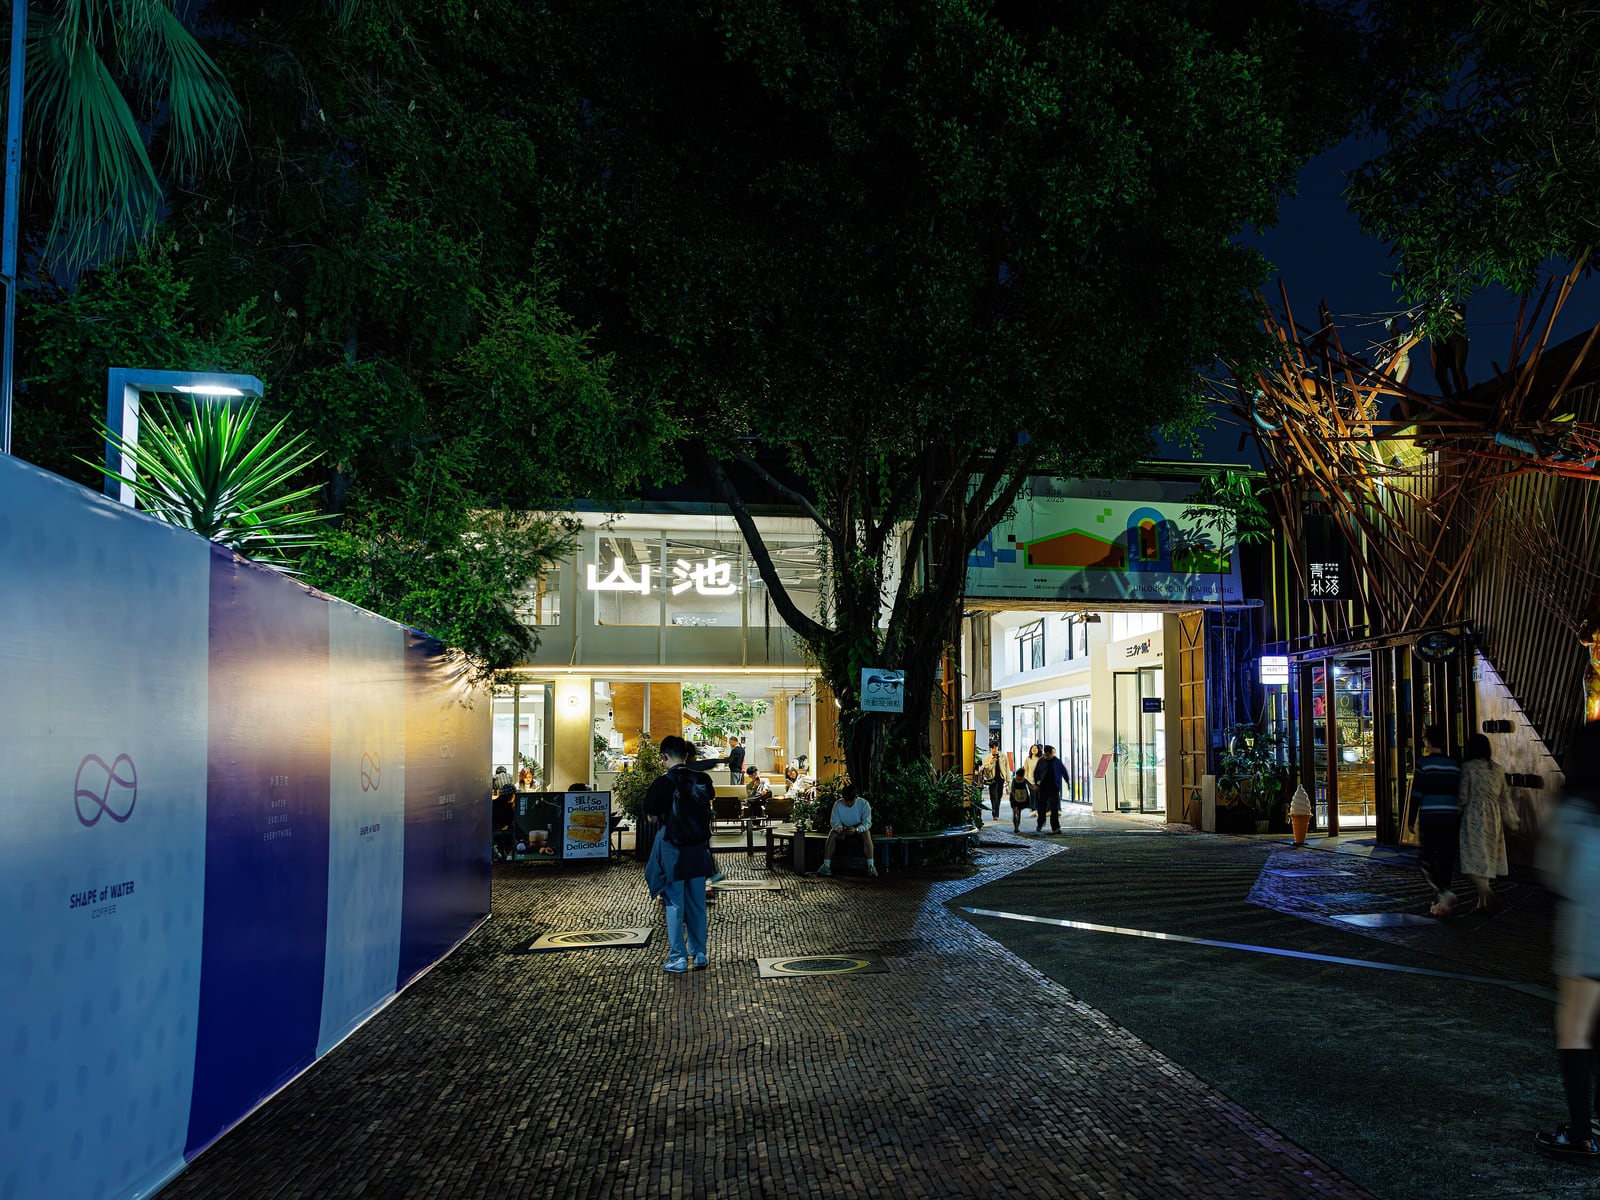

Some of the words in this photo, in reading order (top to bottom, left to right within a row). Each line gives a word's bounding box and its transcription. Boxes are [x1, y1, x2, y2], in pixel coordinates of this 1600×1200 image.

[587, 557, 737, 596] 山池
[1133, 585, 1162, 593] UNLOCK
[1165, 585, 1183, 593] YOUR
[1186, 585, 1202, 593] NEW
[566, 840, 607, 851] Delicious!
[69, 888, 97, 909] SHAPE
[99, 885, 109, 901] of
[110, 880, 136, 899] WATER
[91, 904, 117, 919] COFFEE
